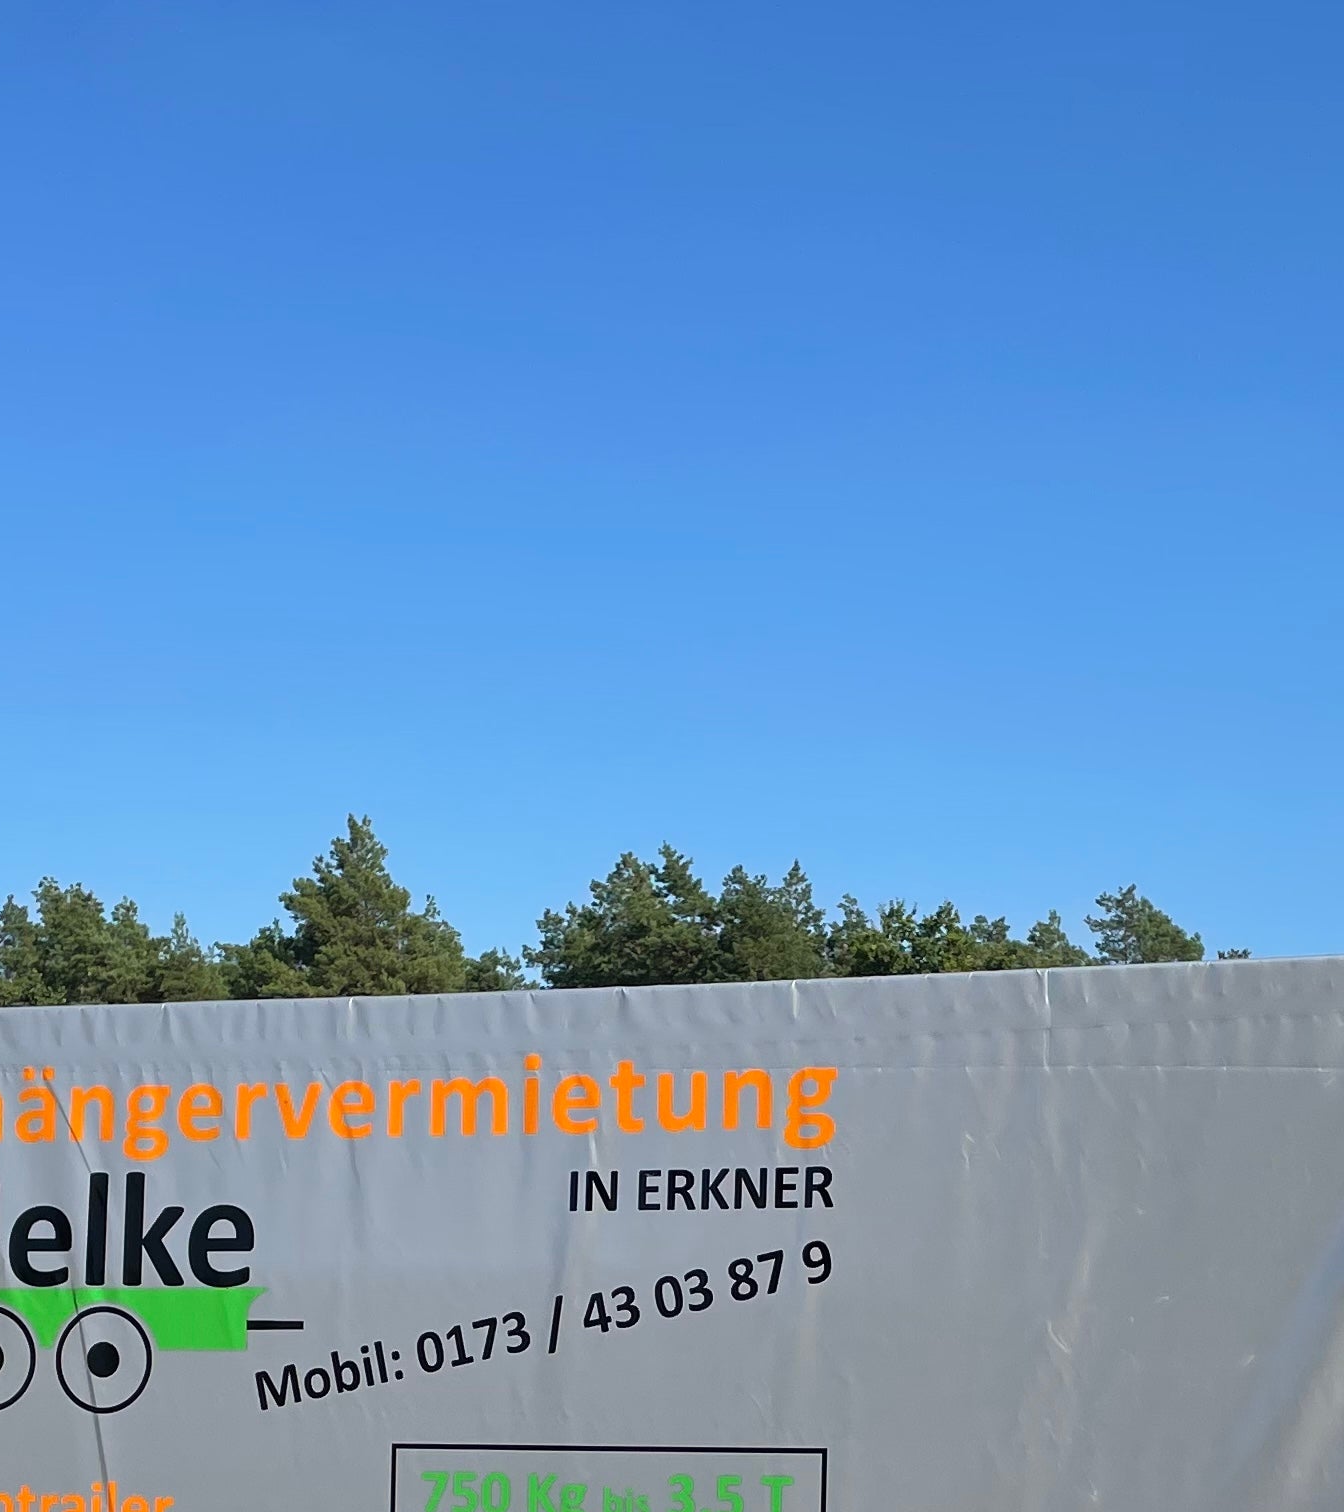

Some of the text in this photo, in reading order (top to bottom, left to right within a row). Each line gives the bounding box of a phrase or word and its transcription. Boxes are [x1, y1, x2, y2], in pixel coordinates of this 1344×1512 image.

[568, 1166, 834, 1213] IN ERKNER
[255, 1240, 832, 1411] Mobil: 0173 / 43 03 87 9
